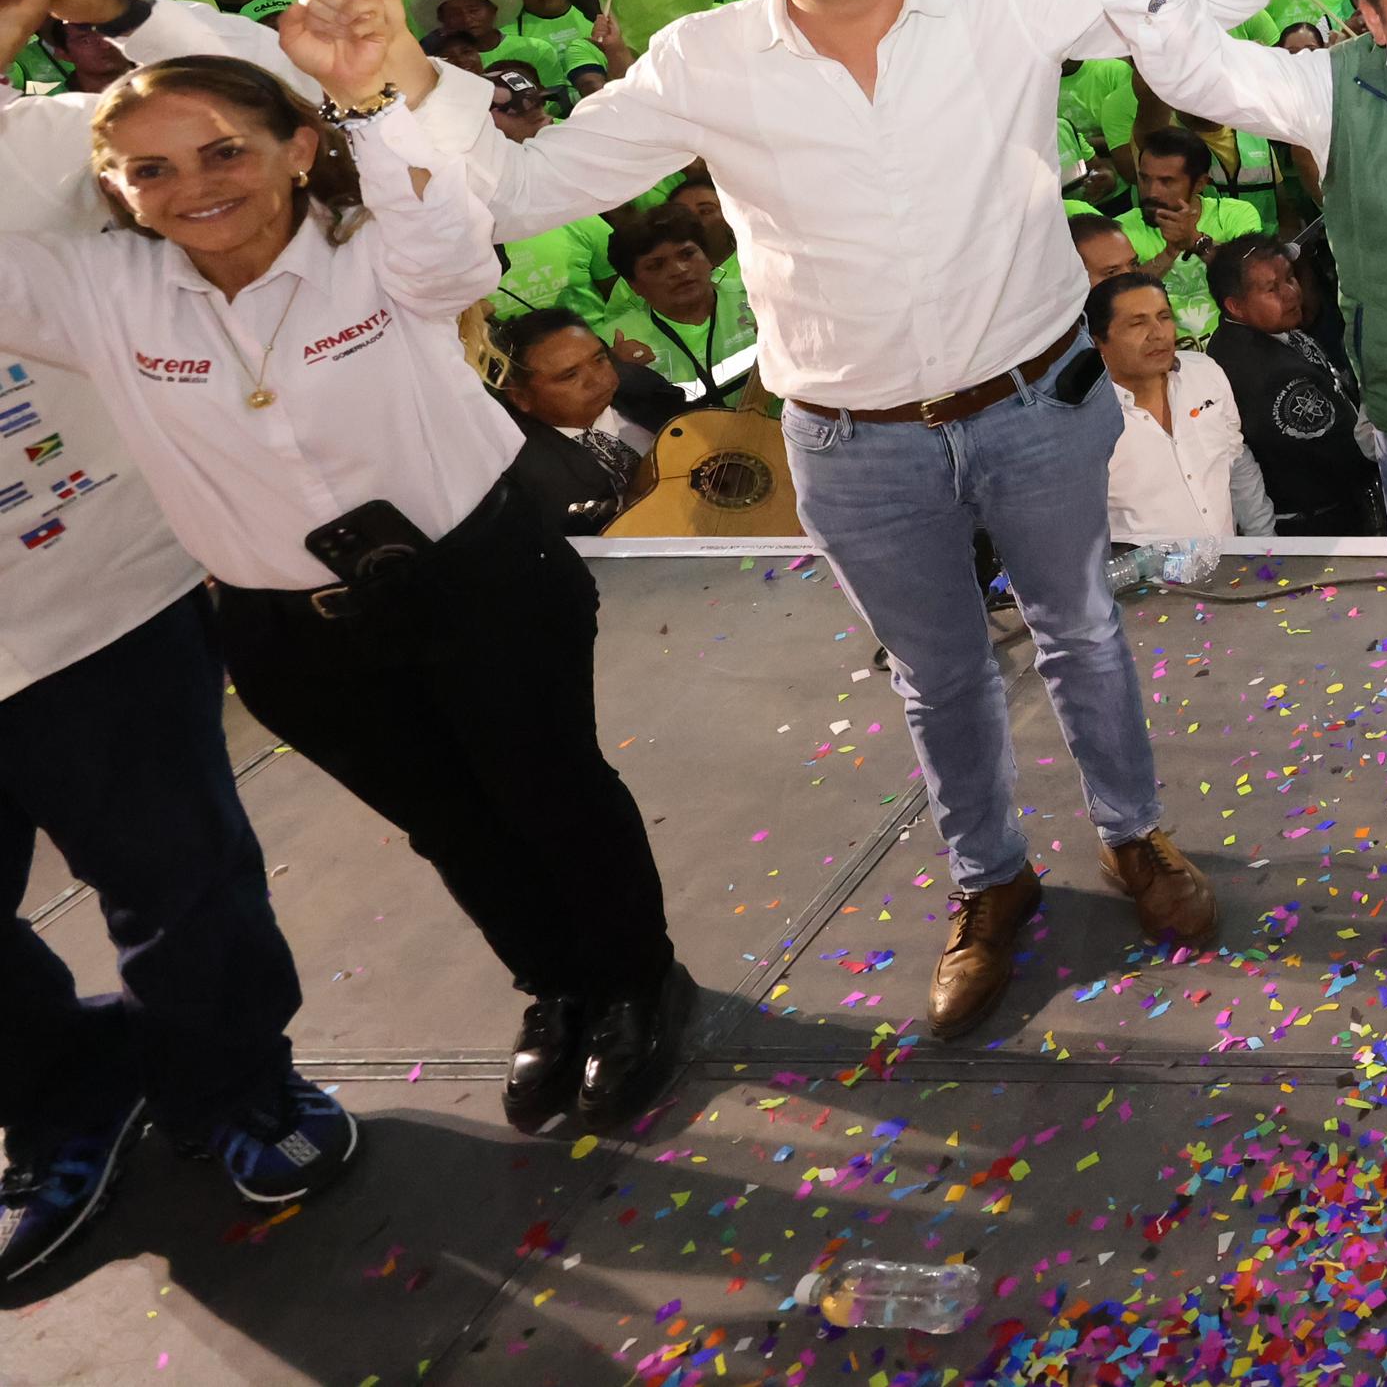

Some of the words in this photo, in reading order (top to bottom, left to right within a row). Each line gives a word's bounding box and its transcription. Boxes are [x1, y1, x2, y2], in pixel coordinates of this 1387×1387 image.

[304, 309, 388, 359] ARMENTA
[332, 330, 386, 362] GOBERNADOR
[136, 352, 212, 374] morena
